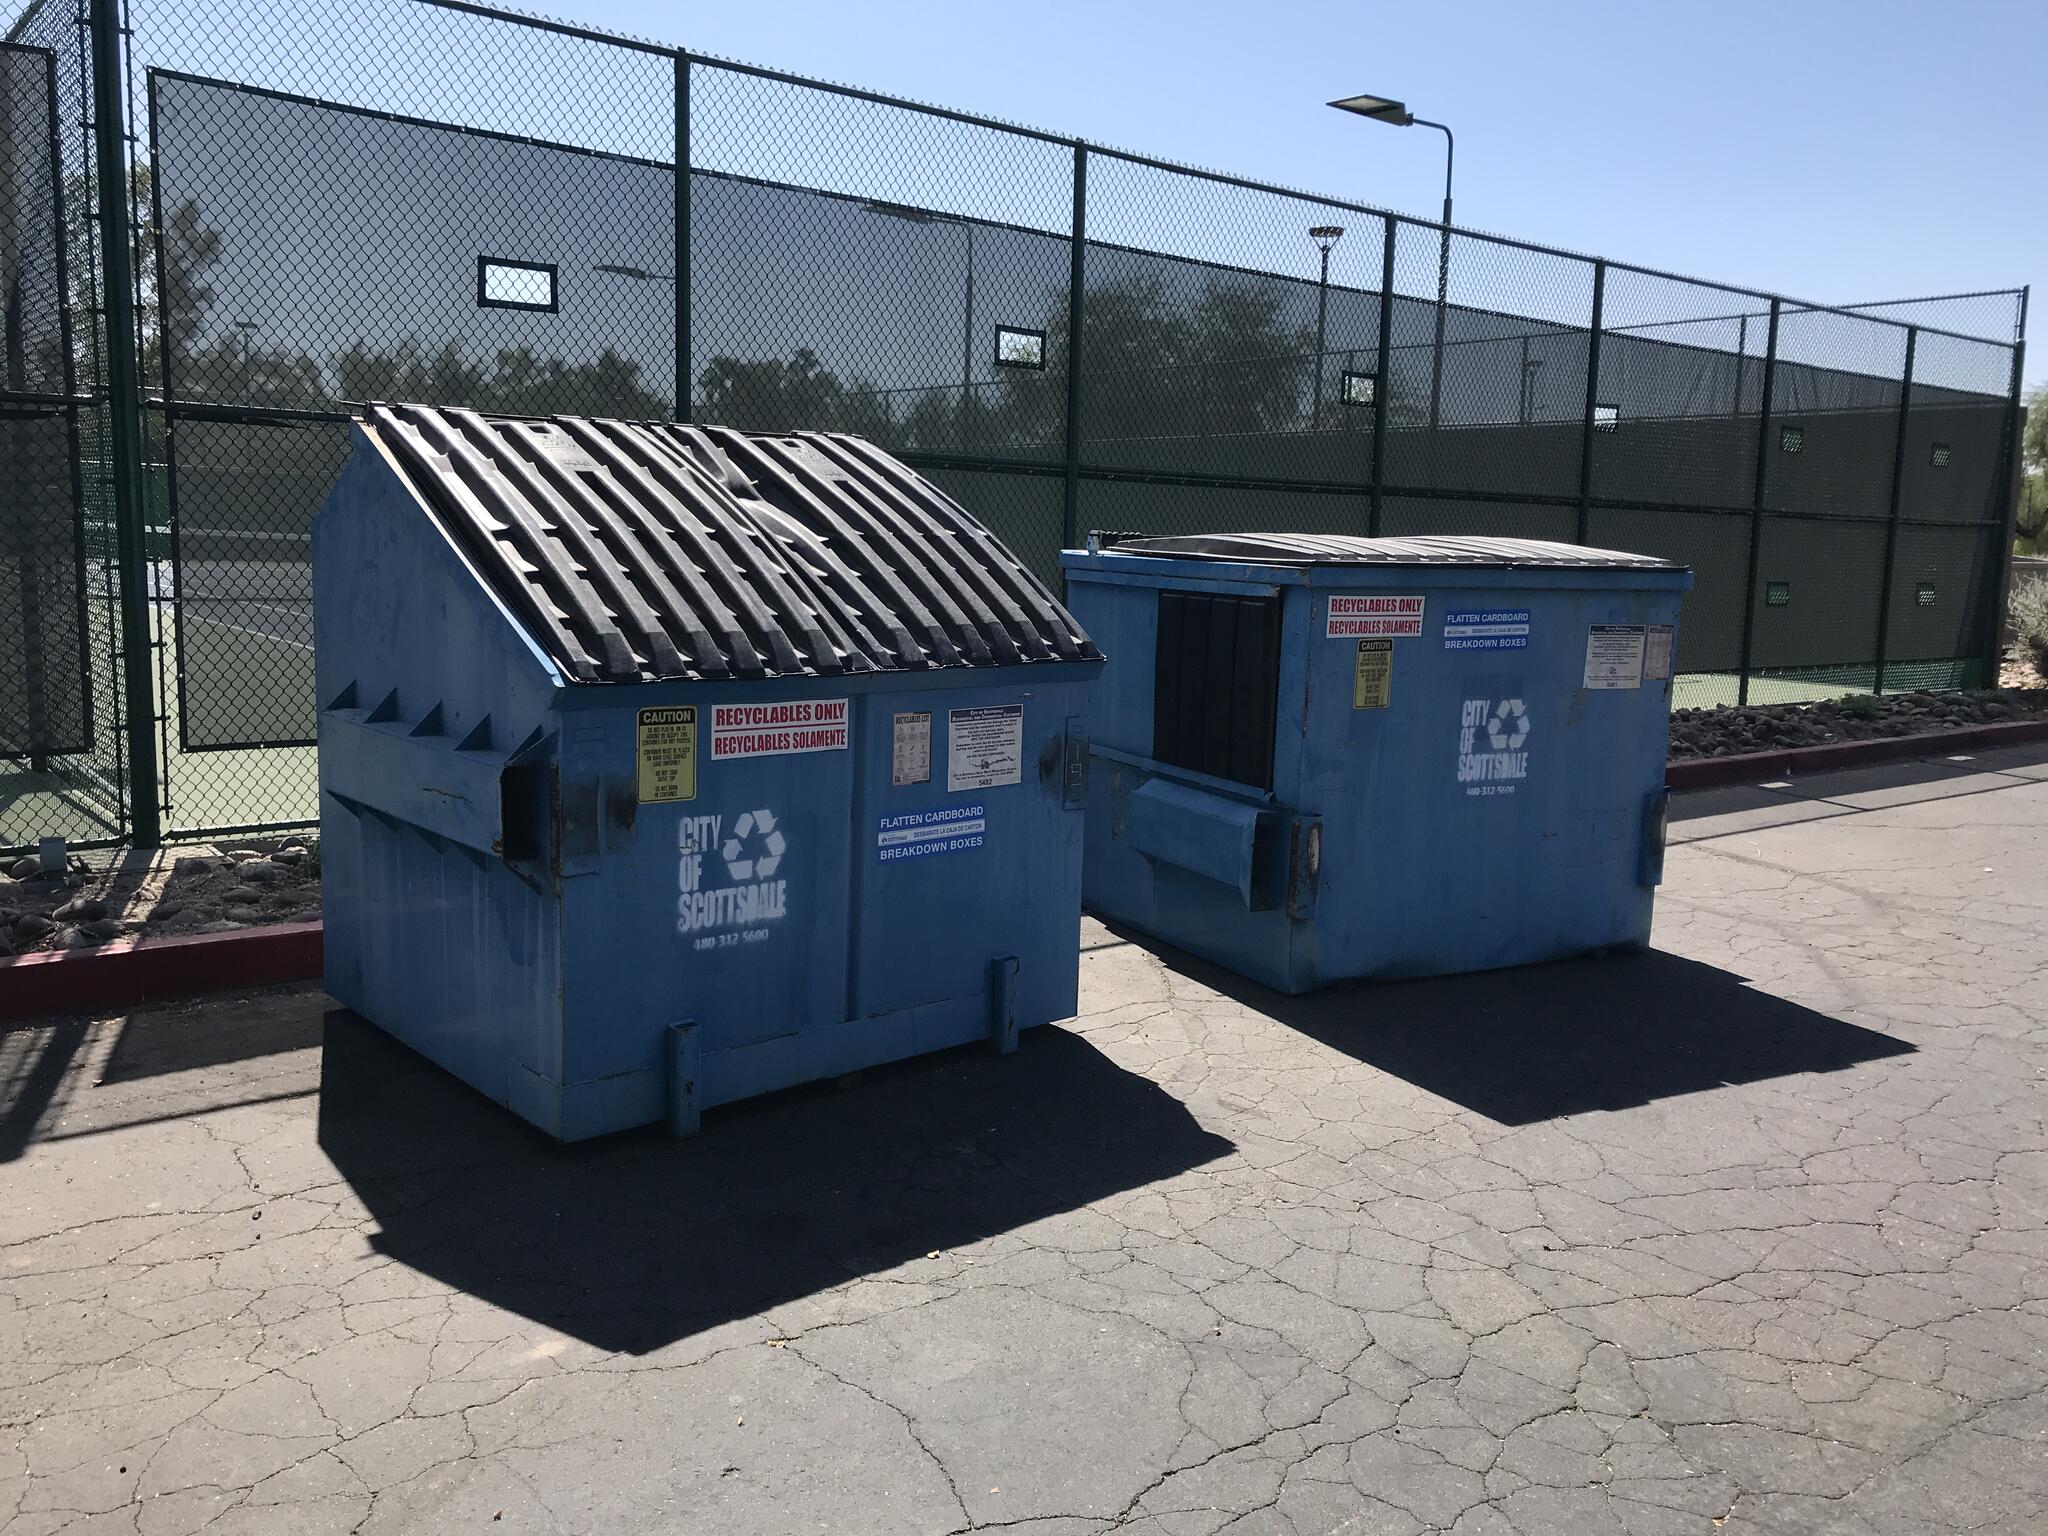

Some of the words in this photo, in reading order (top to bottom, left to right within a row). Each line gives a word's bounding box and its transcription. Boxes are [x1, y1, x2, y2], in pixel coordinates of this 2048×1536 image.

[1331, 599, 1397, 613] RECYCLABLES
[1399, 599, 1423, 613] ONLY
[1447, 614, 1481, 623] FLATTEN
[1482, 613, 1529, 622] CARDBOARD
[1329, 620, 1381, 635] RECYCLABLES
[1382, 620, 1421, 634] SOLAMENTE
[1361, 641, 1391, 651] CAUTION
[1445, 639, 1498, 649] BREAKDOWN
[1500, 638, 1527, 647] BOXES
[643, 710, 691, 723] CAUTION
[716, 703, 812, 726] RECYCLABLES
[814, 702, 846, 721] ONLY
[1462, 700, 1491, 727] CITY
[715, 733, 790, 755] RECYCLABLES
[793, 729, 846, 750] SOLAMENTE
[1460, 727, 1476, 755] OF
[1457, 752, 1529, 782] SCOTTSDALE
[880, 813, 923, 829] FLATTEN
[925, 806, 984, 823] CARDBOARD
[680, 814, 722, 855] CITY
[880, 841, 948, 861] BREAKDOWN
[950, 836, 984, 850] BOXES
[680, 854, 703, 893] OF
[678, 880, 786, 932] SCOTTSDALE
